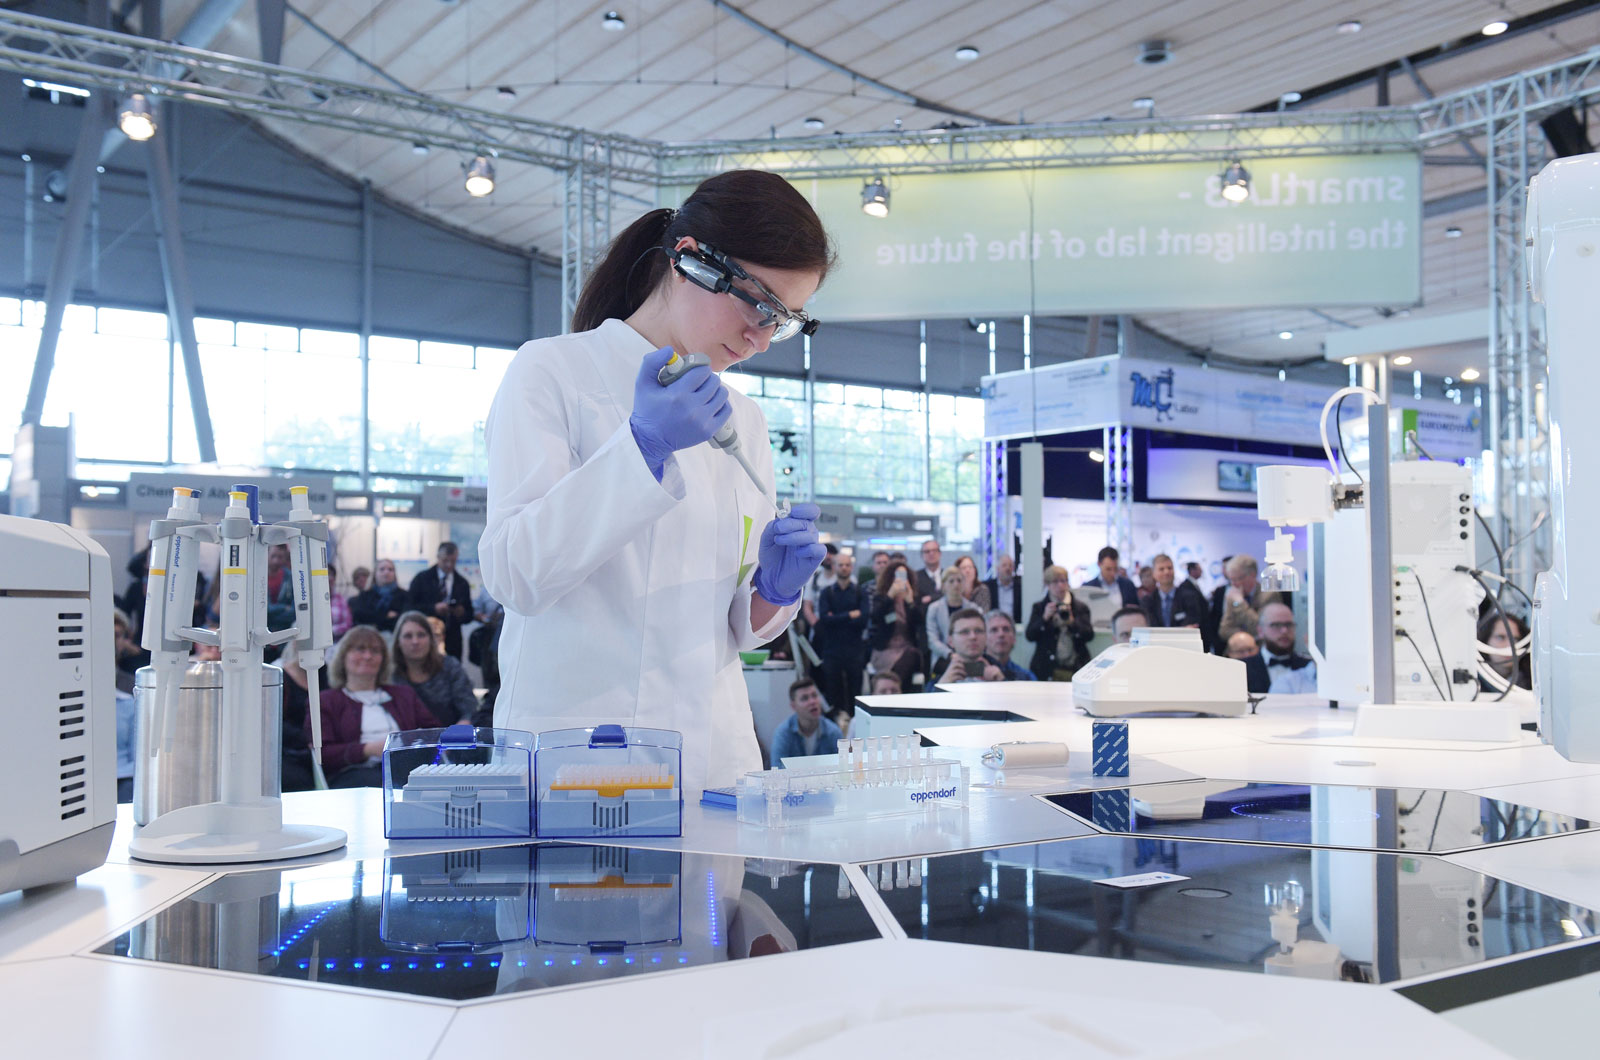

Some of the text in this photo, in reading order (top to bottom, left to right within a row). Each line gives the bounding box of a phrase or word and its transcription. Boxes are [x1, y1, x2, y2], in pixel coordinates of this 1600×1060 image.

[173, 535, 182, 568] eppendorf
[299, 570, 307, 600] eppendorf
[910, 787, 957, 803] eppendorf
